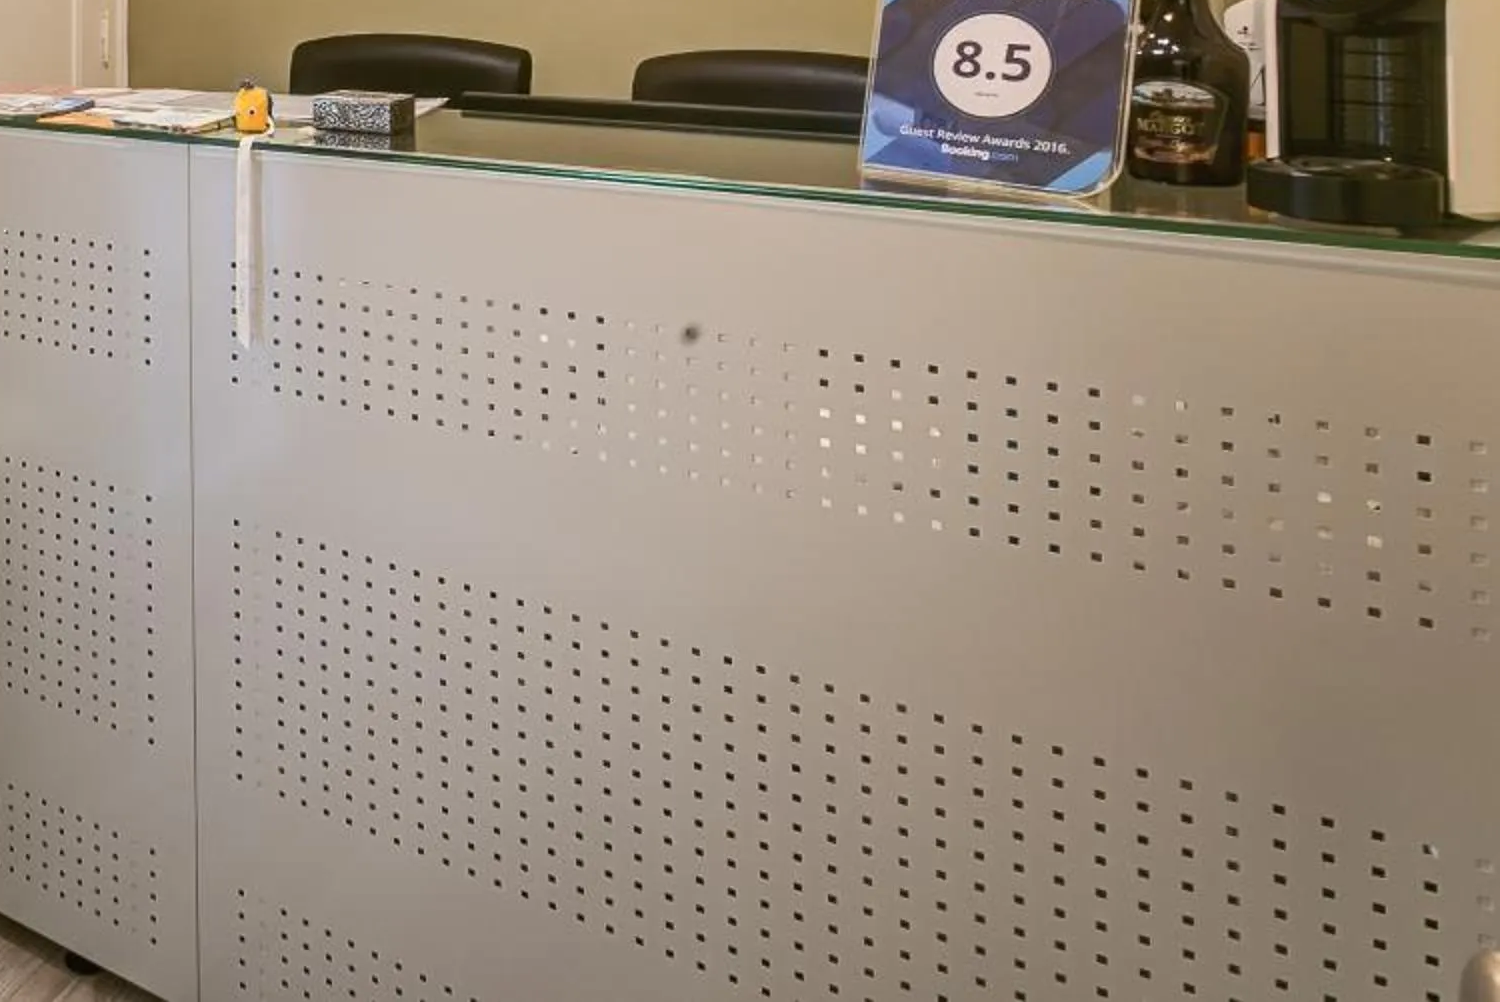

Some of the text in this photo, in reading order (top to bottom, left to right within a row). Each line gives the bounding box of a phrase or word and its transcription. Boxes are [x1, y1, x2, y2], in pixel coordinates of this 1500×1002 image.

[952, 40, 1032, 82] 8.5
[899, 125, 935, 139] Guest
[937, 129, 981, 144] Review
[982, 134, 1031, 150] Awards
